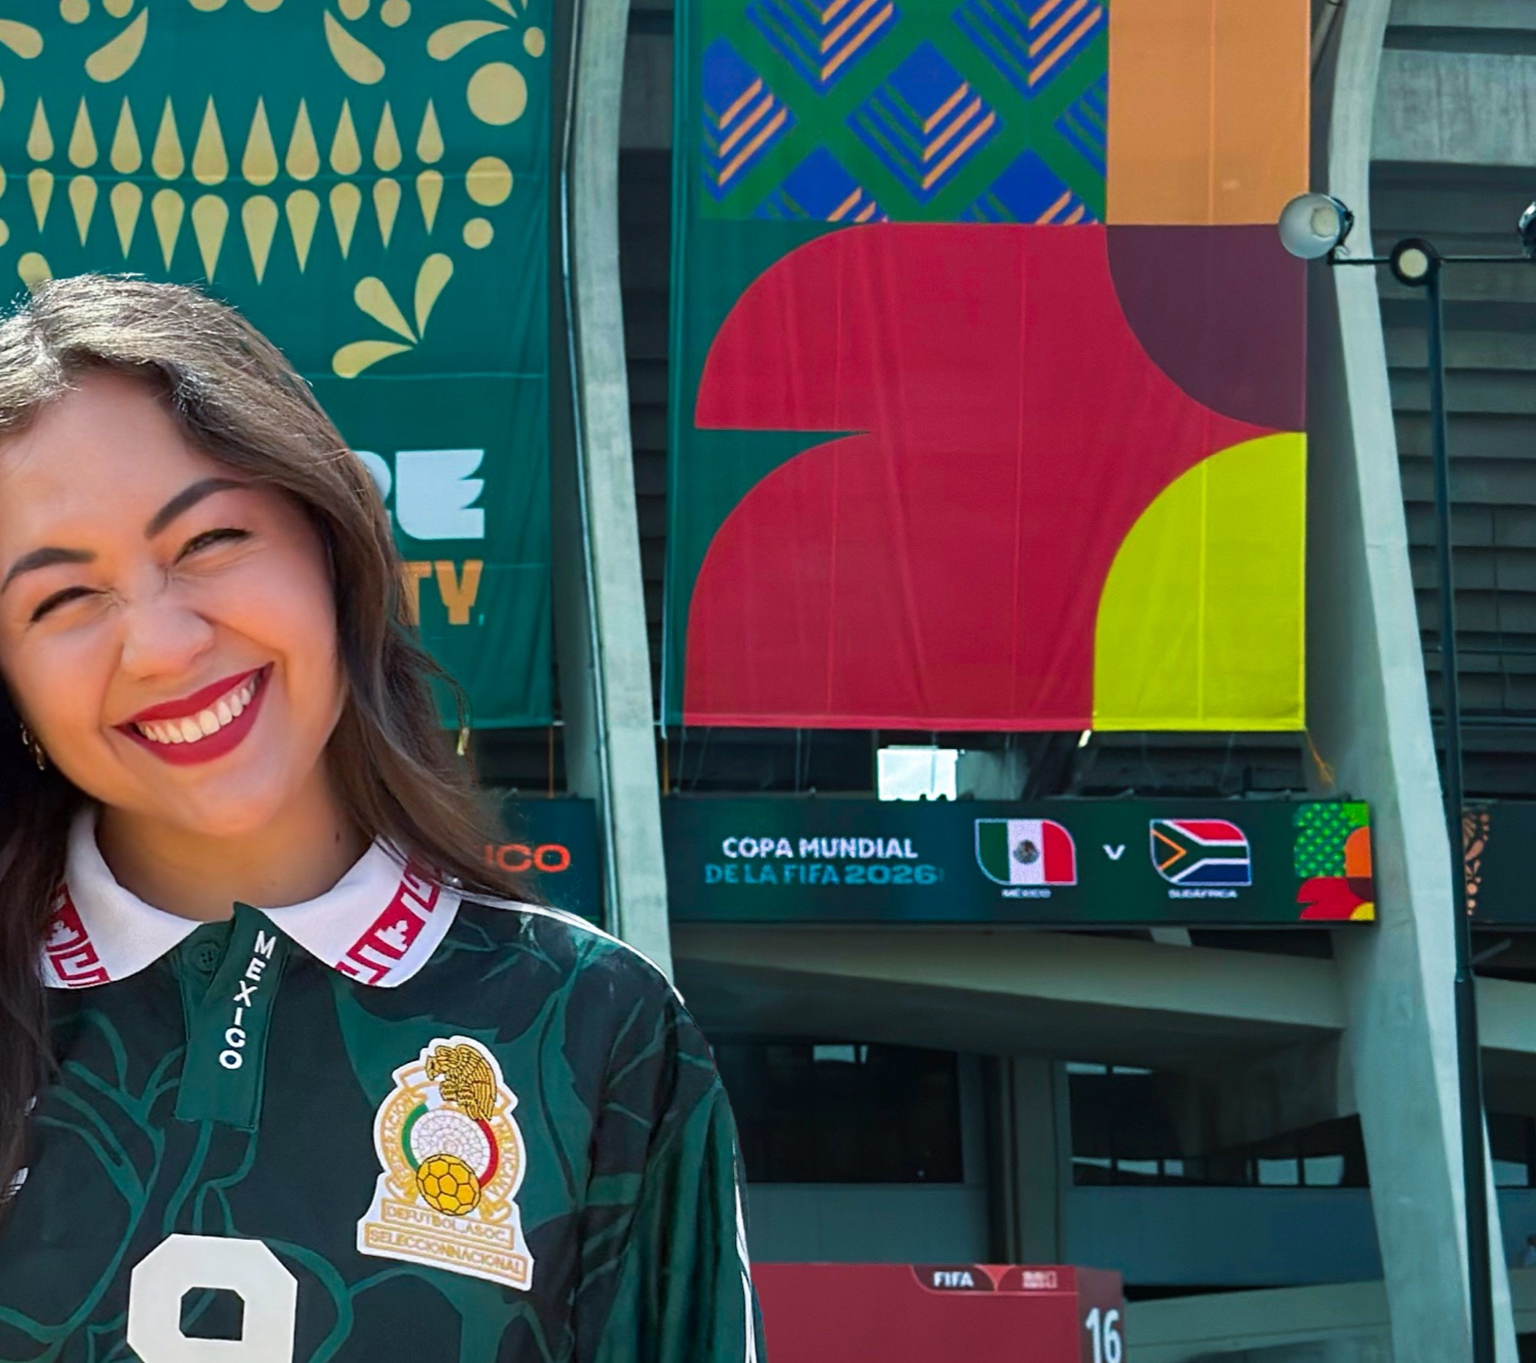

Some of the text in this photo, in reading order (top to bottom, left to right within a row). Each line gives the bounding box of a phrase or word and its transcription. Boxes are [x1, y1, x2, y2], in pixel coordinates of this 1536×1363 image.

[722, 837, 918, 859] COPA MUNDIAL
[704, 863, 938, 886] DE LA FIFA 2026
[218, 930, 277, 1070] MEXICO
[933, 1270, 975, 1288] FIFA
